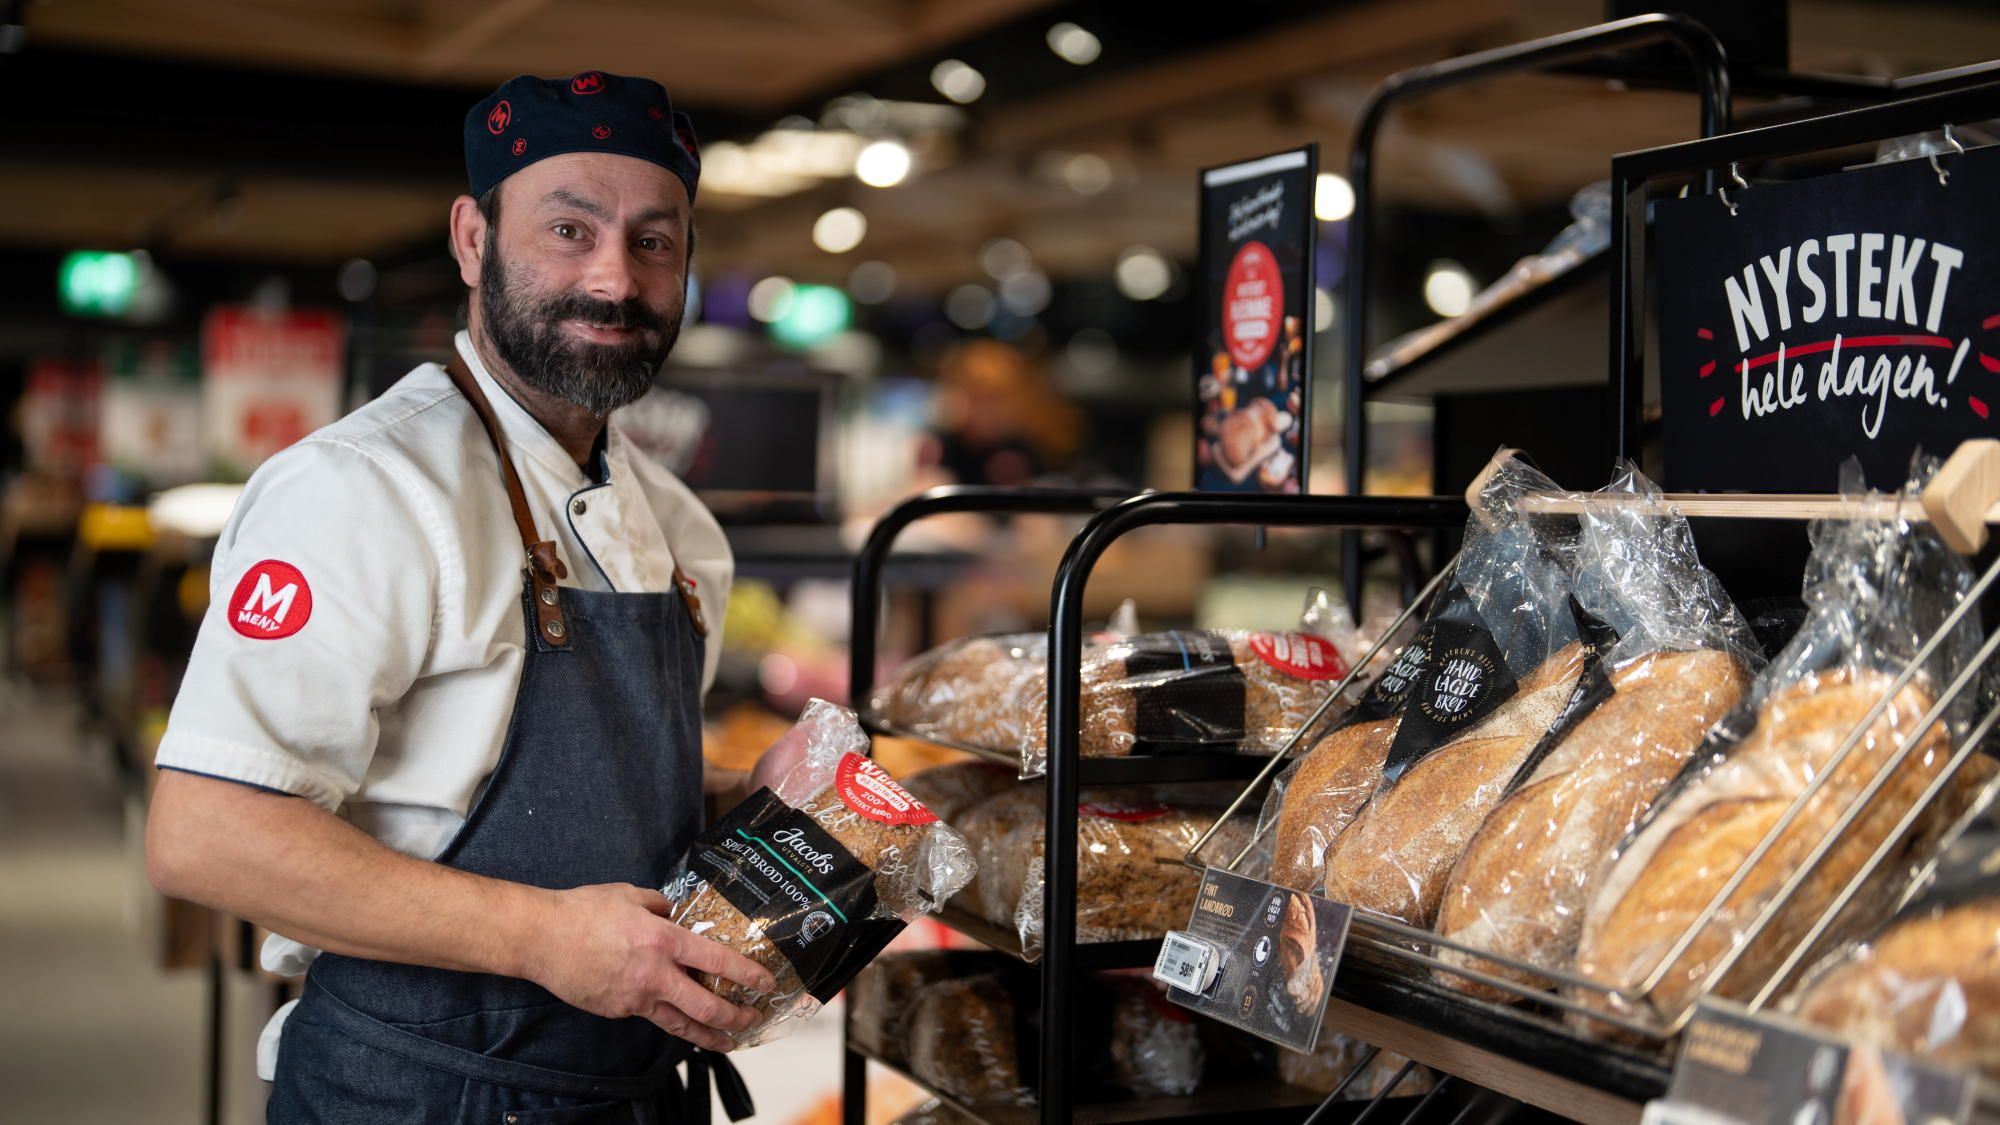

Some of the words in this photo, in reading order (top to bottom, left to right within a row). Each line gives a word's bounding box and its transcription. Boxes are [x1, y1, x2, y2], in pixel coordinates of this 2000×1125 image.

[1724, 232, 1964, 353] NYSTEKT
[1740, 341, 1808, 421] hele
[1817, 332, 1971, 440] dagen!
[243, 572, 298, 624] M
[238, 610, 281, 632] MENY
[1434, 675, 1482, 698] LAGDE
[1434, 693, 1468, 713] BRØD
[772, 828, 835, 876] Jacobs
[781, 846, 815, 875] UTVALGTE
[779, 880, 812, 912] 100%
[1204, 883, 1219, 897] FINT
